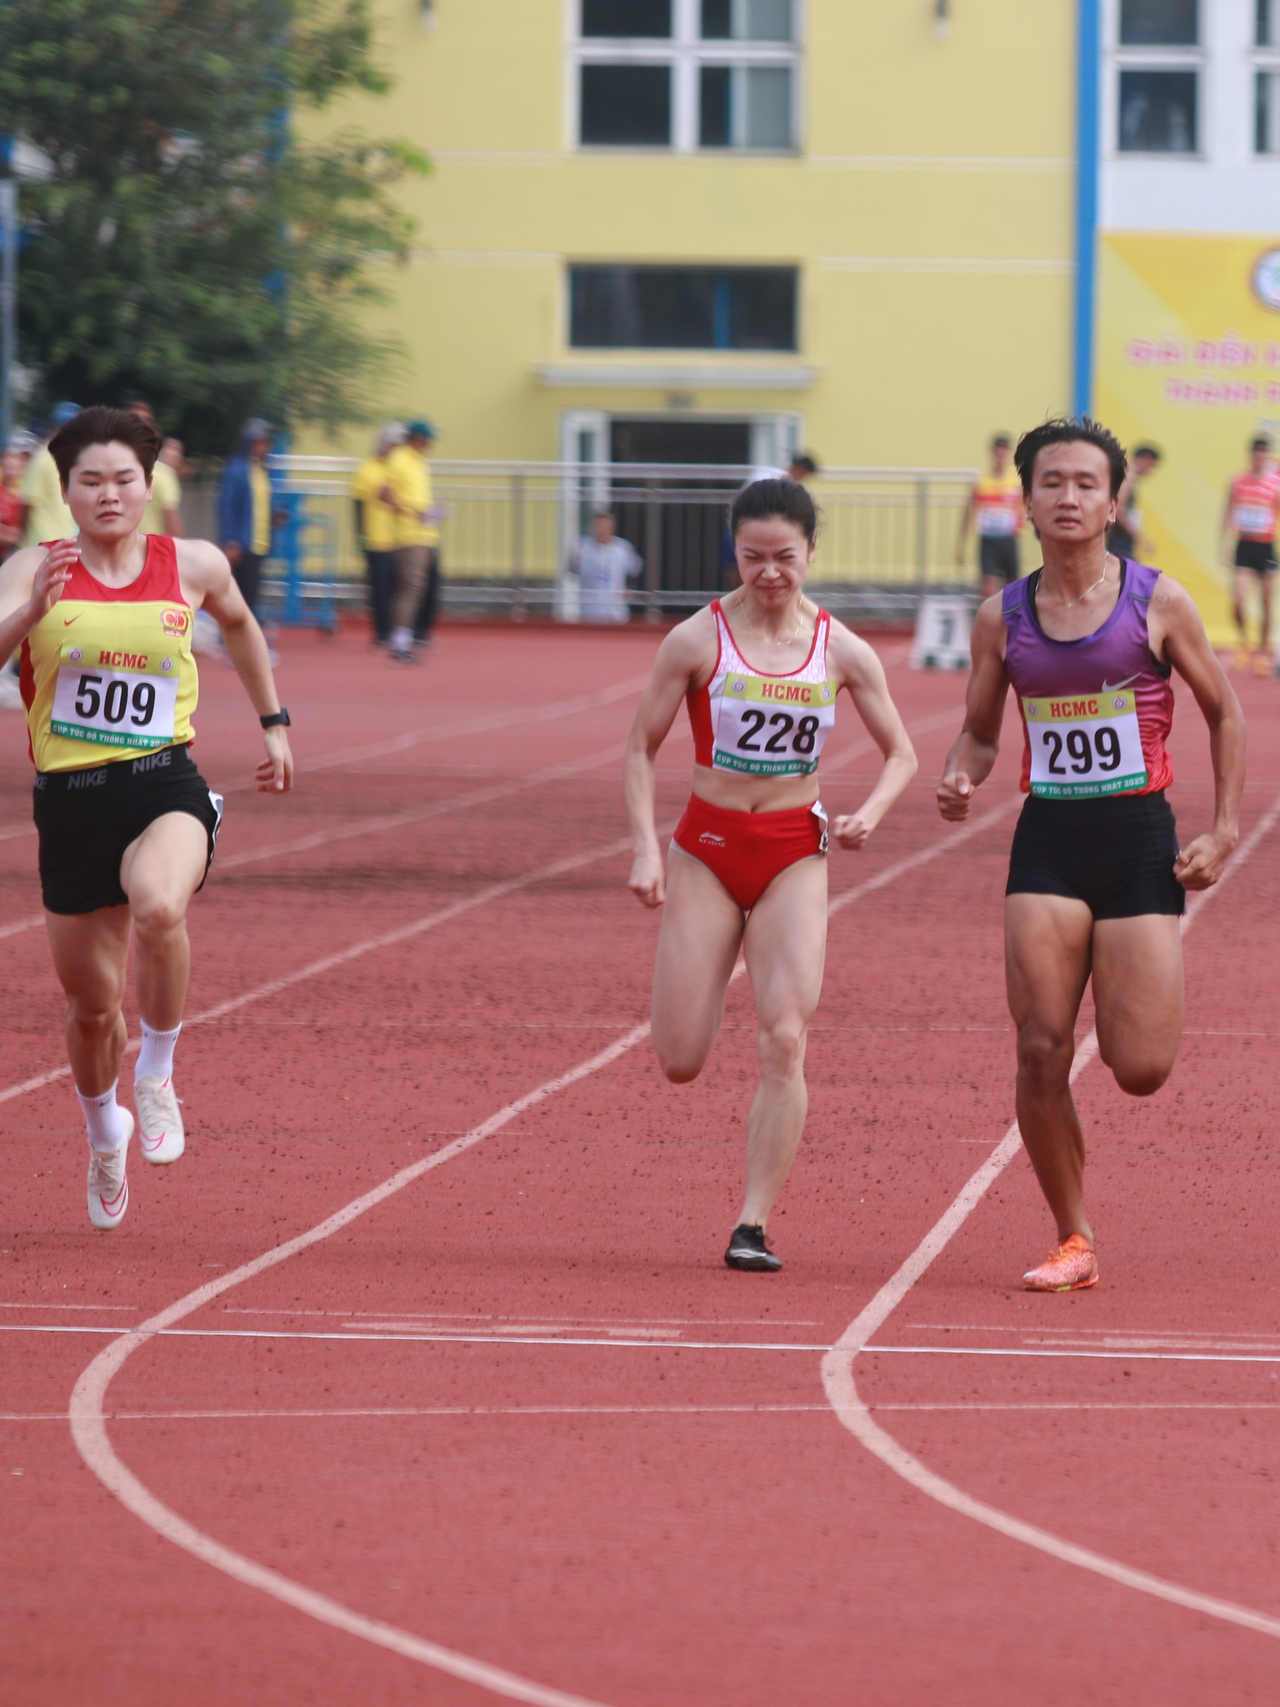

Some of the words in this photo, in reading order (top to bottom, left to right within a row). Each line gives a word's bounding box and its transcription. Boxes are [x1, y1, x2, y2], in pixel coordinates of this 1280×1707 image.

[98, 650, 149, 670] HCMC
[75, 674, 156, 727] 509
[761, 683, 812, 703] HCMC
[1049, 699, 1099, 718] HCMC
[737, 709, 820, 755] 228
[1042, 726, 1121, 775] 299
[131, 751, 172, 775] NIKE
[68, 768, 108, 790] NIKE
[1124, 776, 1145, 788] 2025
